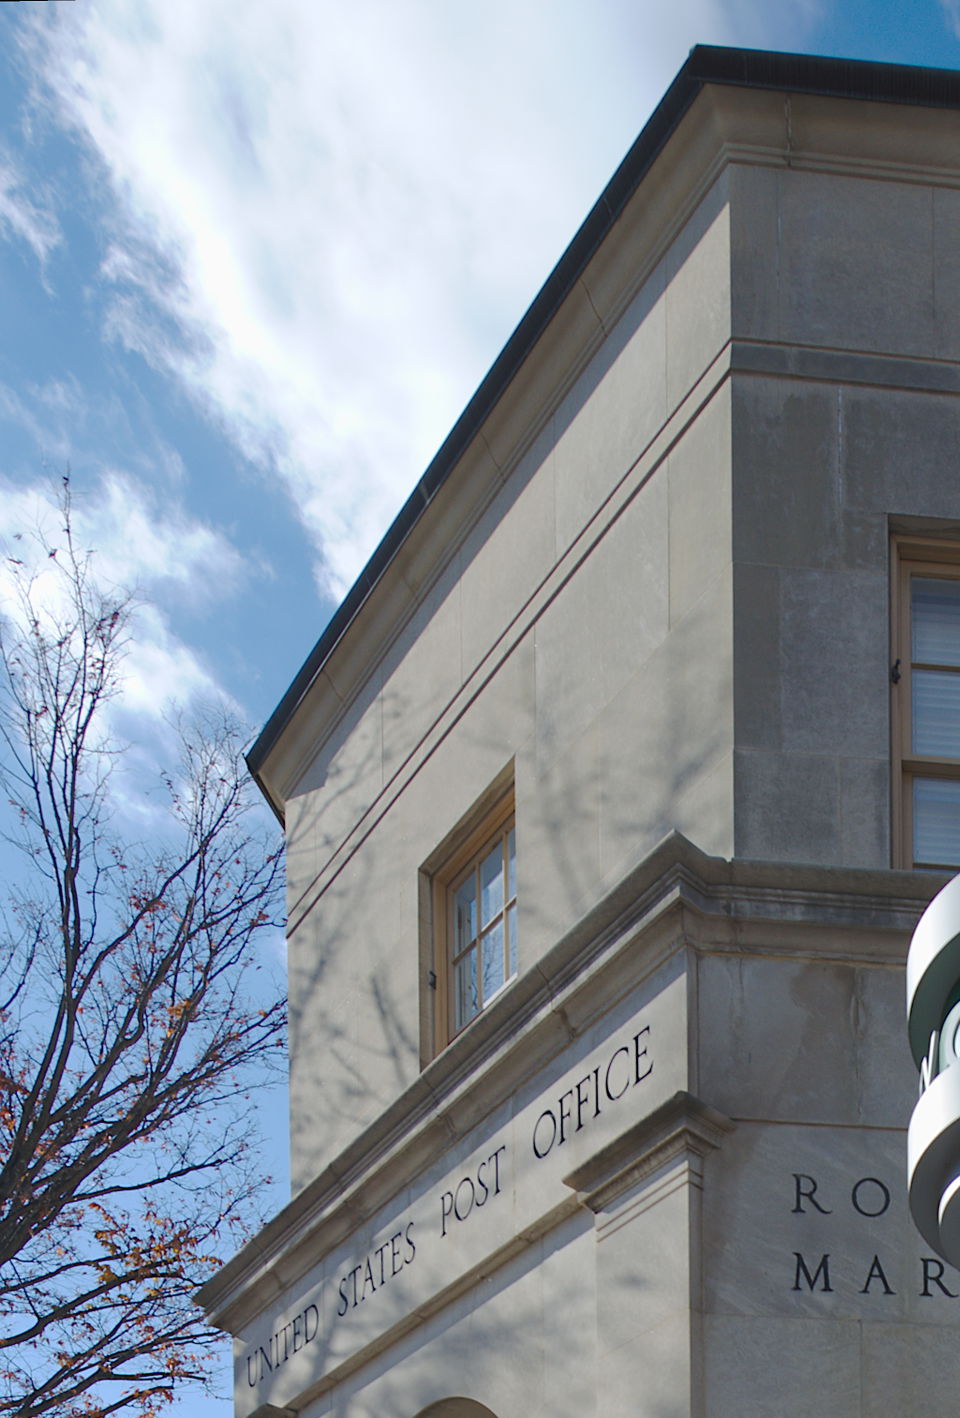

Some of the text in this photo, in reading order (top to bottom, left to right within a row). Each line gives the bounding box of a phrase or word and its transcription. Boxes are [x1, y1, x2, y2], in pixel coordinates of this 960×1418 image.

[247, 1025, 654, 1388] UNITED STATES POST OFFICE
[791, 1172, 891, 1218] RO
[791, 1251, 960, 1299] MAR
